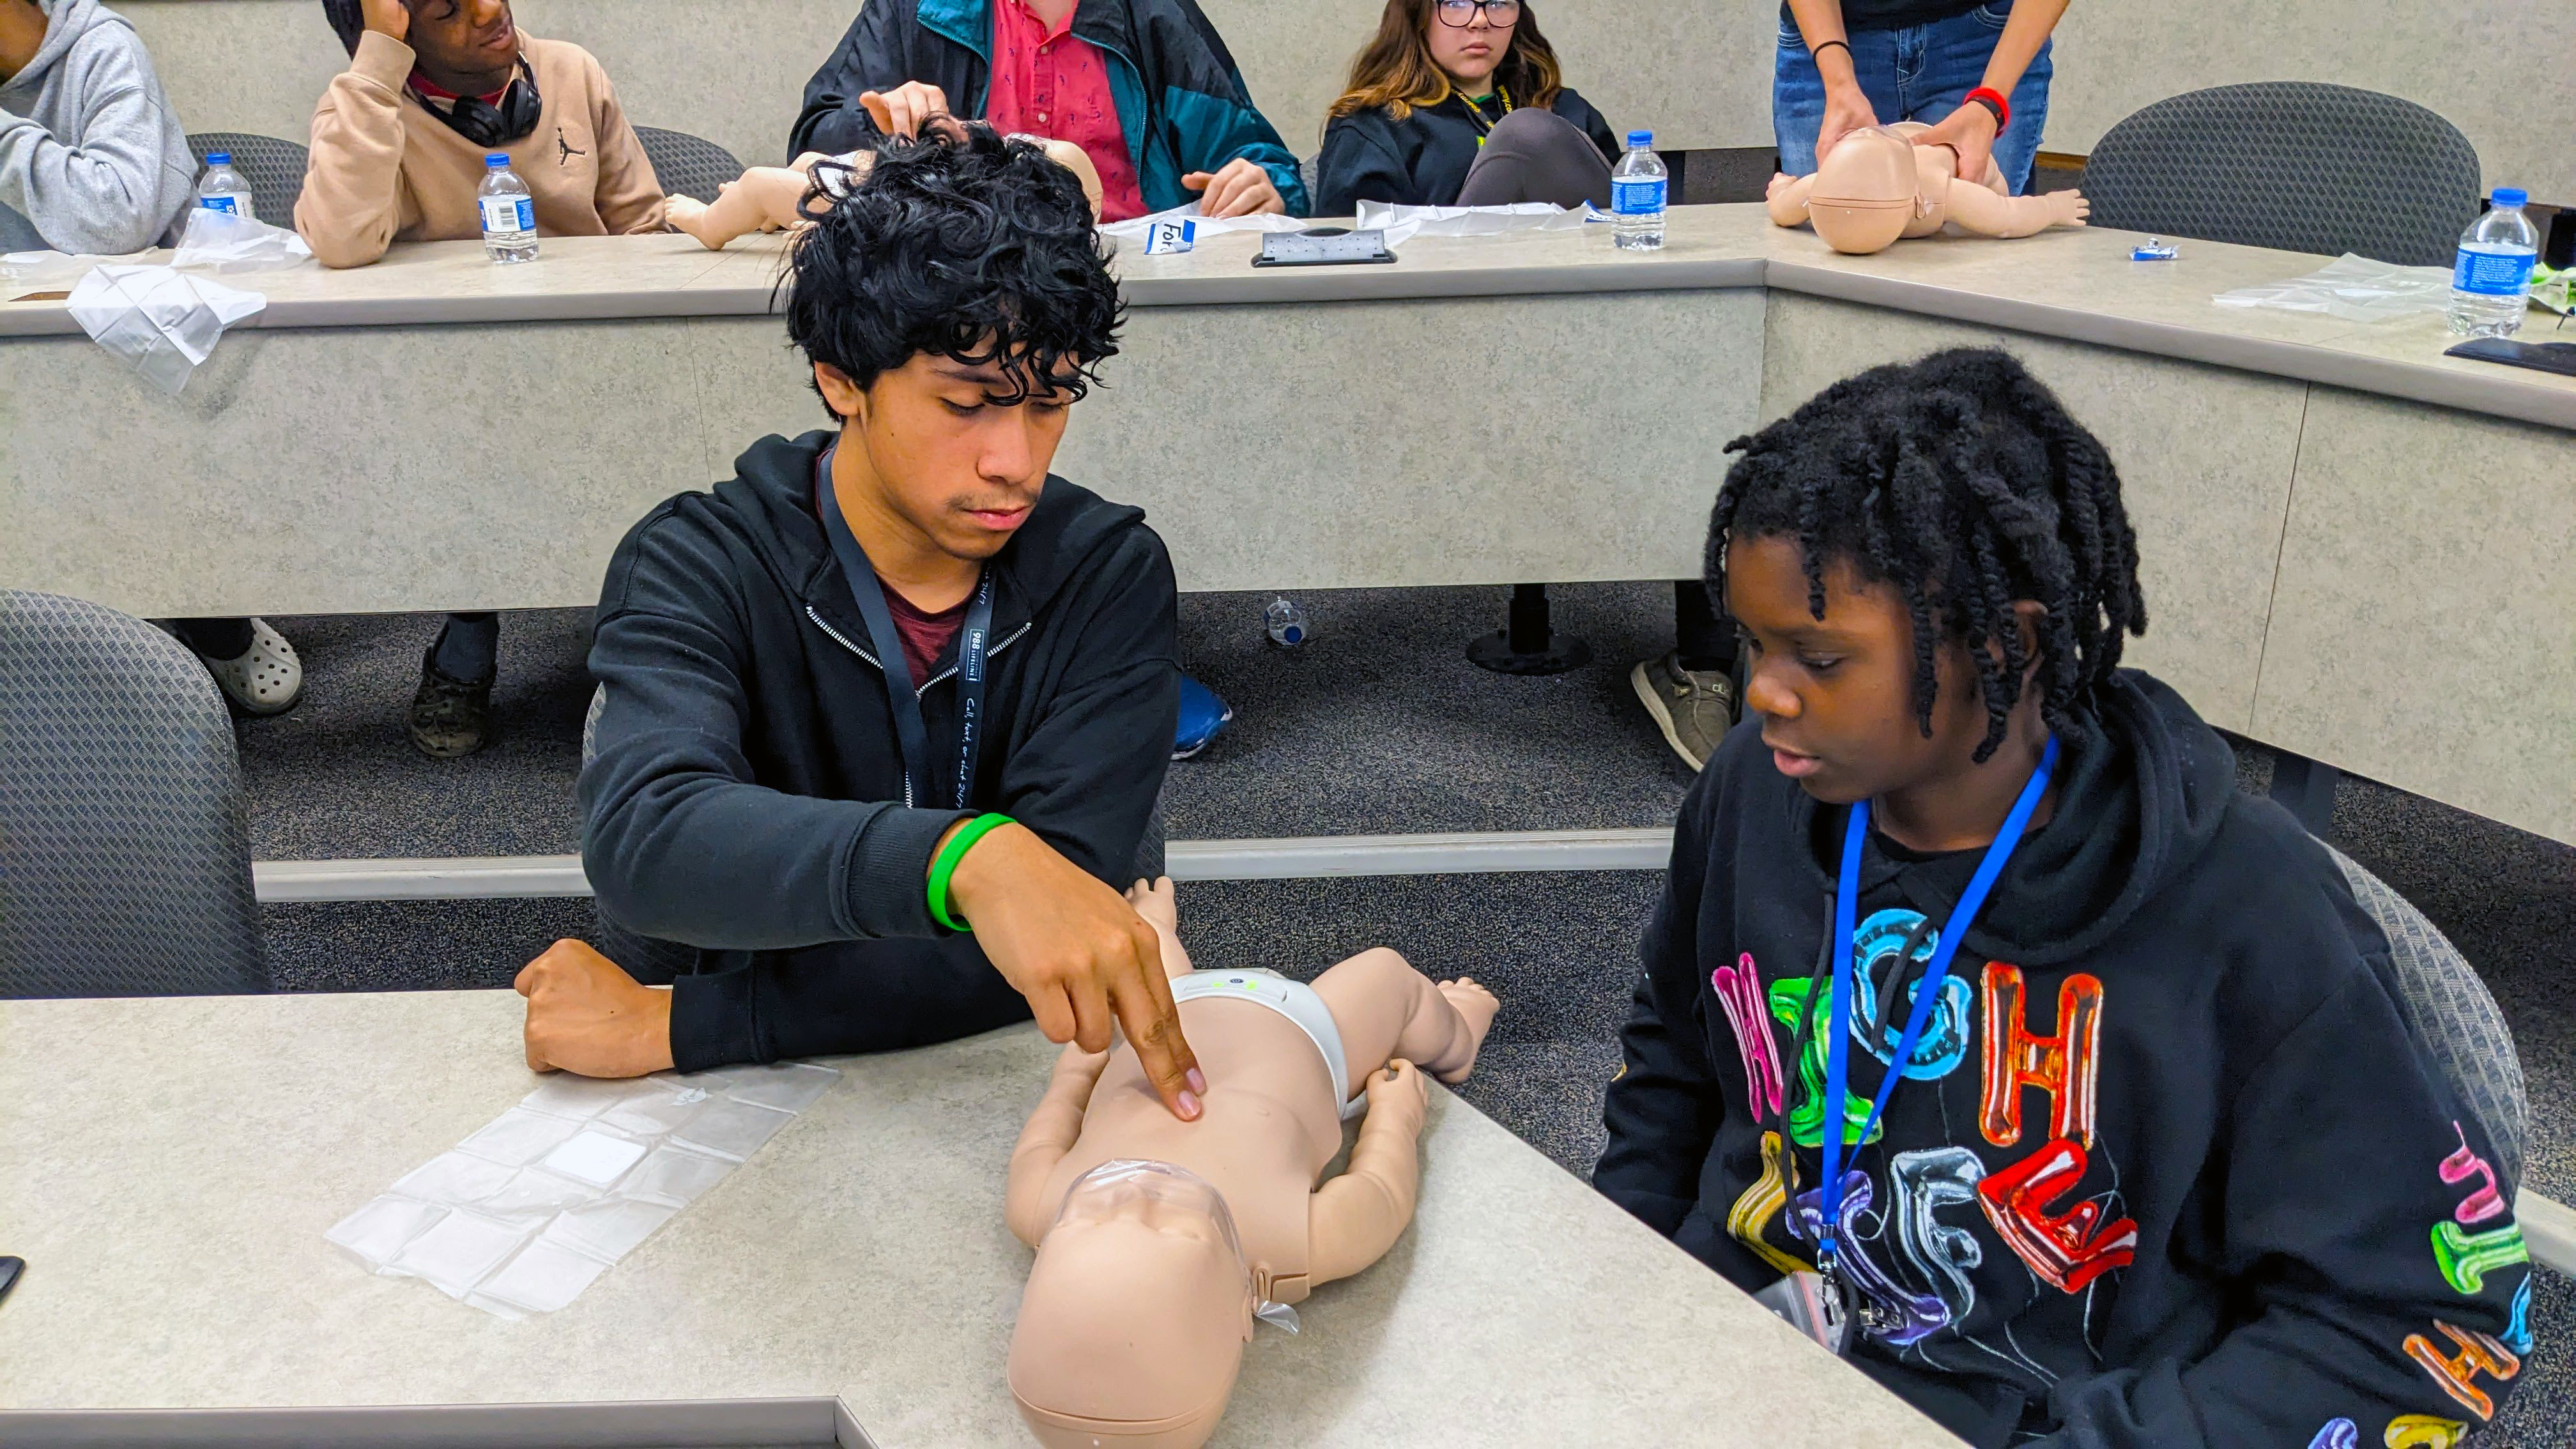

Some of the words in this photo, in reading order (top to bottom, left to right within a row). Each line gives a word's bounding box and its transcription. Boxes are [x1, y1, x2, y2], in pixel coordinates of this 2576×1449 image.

[972, 632, 981, 650] 988
[964, 698, 974, 718] Call,
[963, 746, 968, 757] or
[960, 760, 969, 781] chat
[1711, 908, 2104, 1150] HIGH
[1727, 1130, 2138, 1346] LIFE
